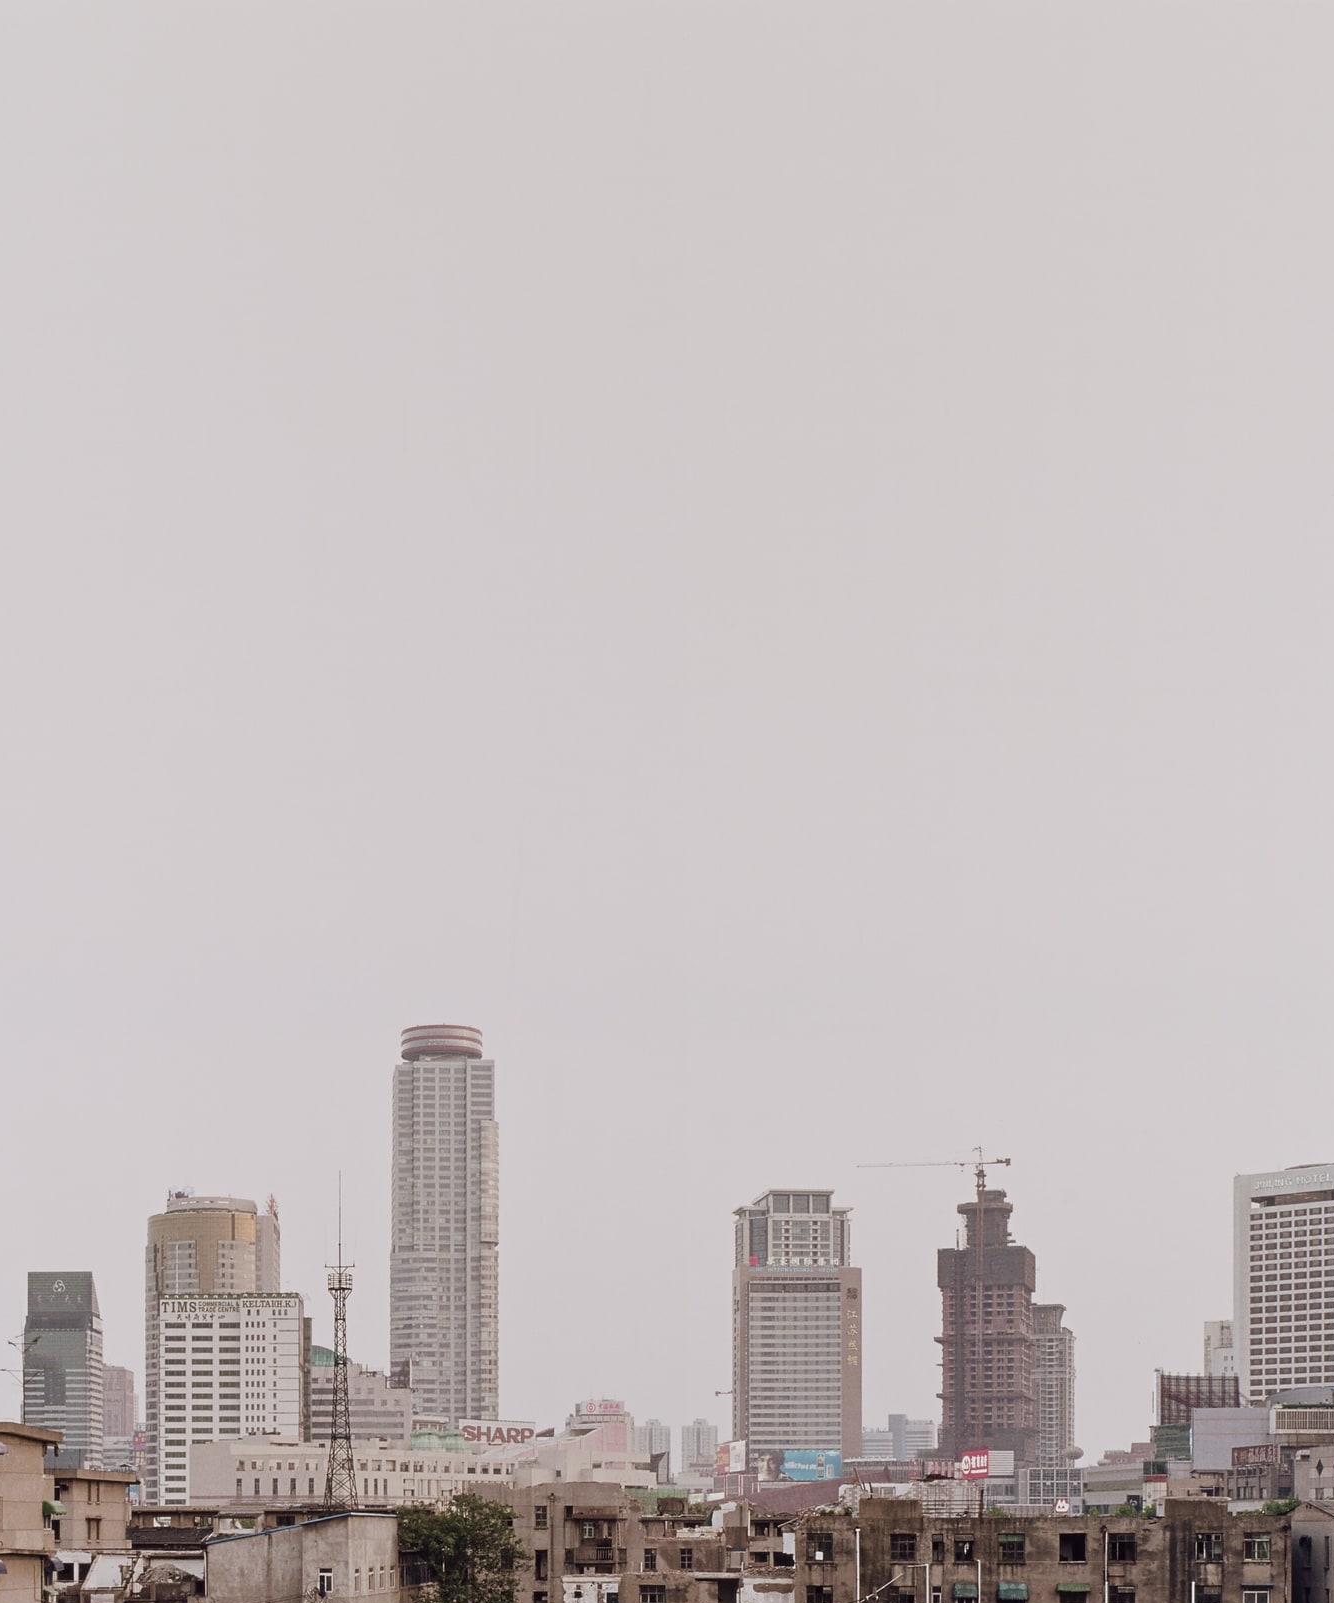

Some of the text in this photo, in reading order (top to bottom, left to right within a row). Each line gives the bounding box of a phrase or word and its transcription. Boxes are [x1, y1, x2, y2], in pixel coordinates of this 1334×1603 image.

[1296, 1173, 1332, 1185] HOTEL
[161, 1301, 197, 1313] TIMS
[462, 1425, 535, 1443] SHARP
